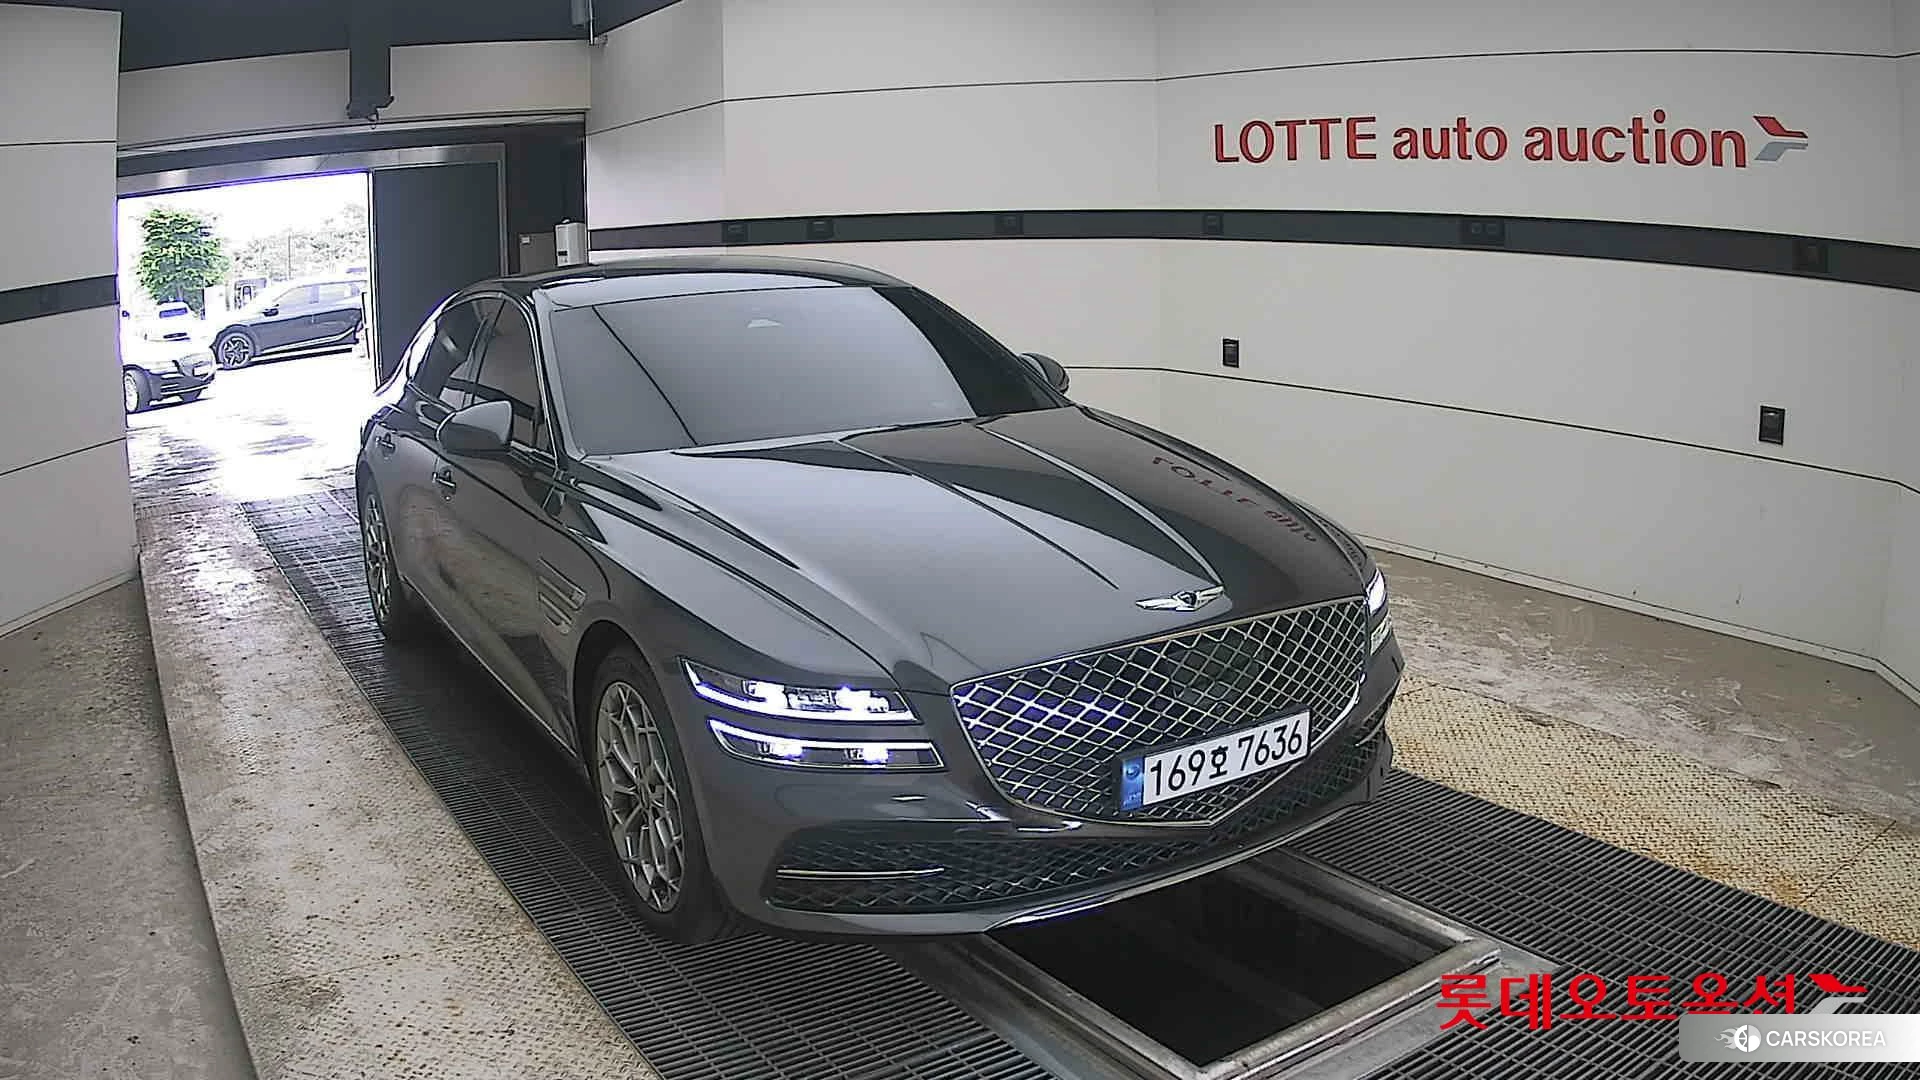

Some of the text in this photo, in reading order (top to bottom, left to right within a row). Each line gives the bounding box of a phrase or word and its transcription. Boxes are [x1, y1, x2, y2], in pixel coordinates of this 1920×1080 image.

[1214, 109, 1747, 167] LOTTE auto auction
[1150, 719, 1303, 797] 169호 7636
